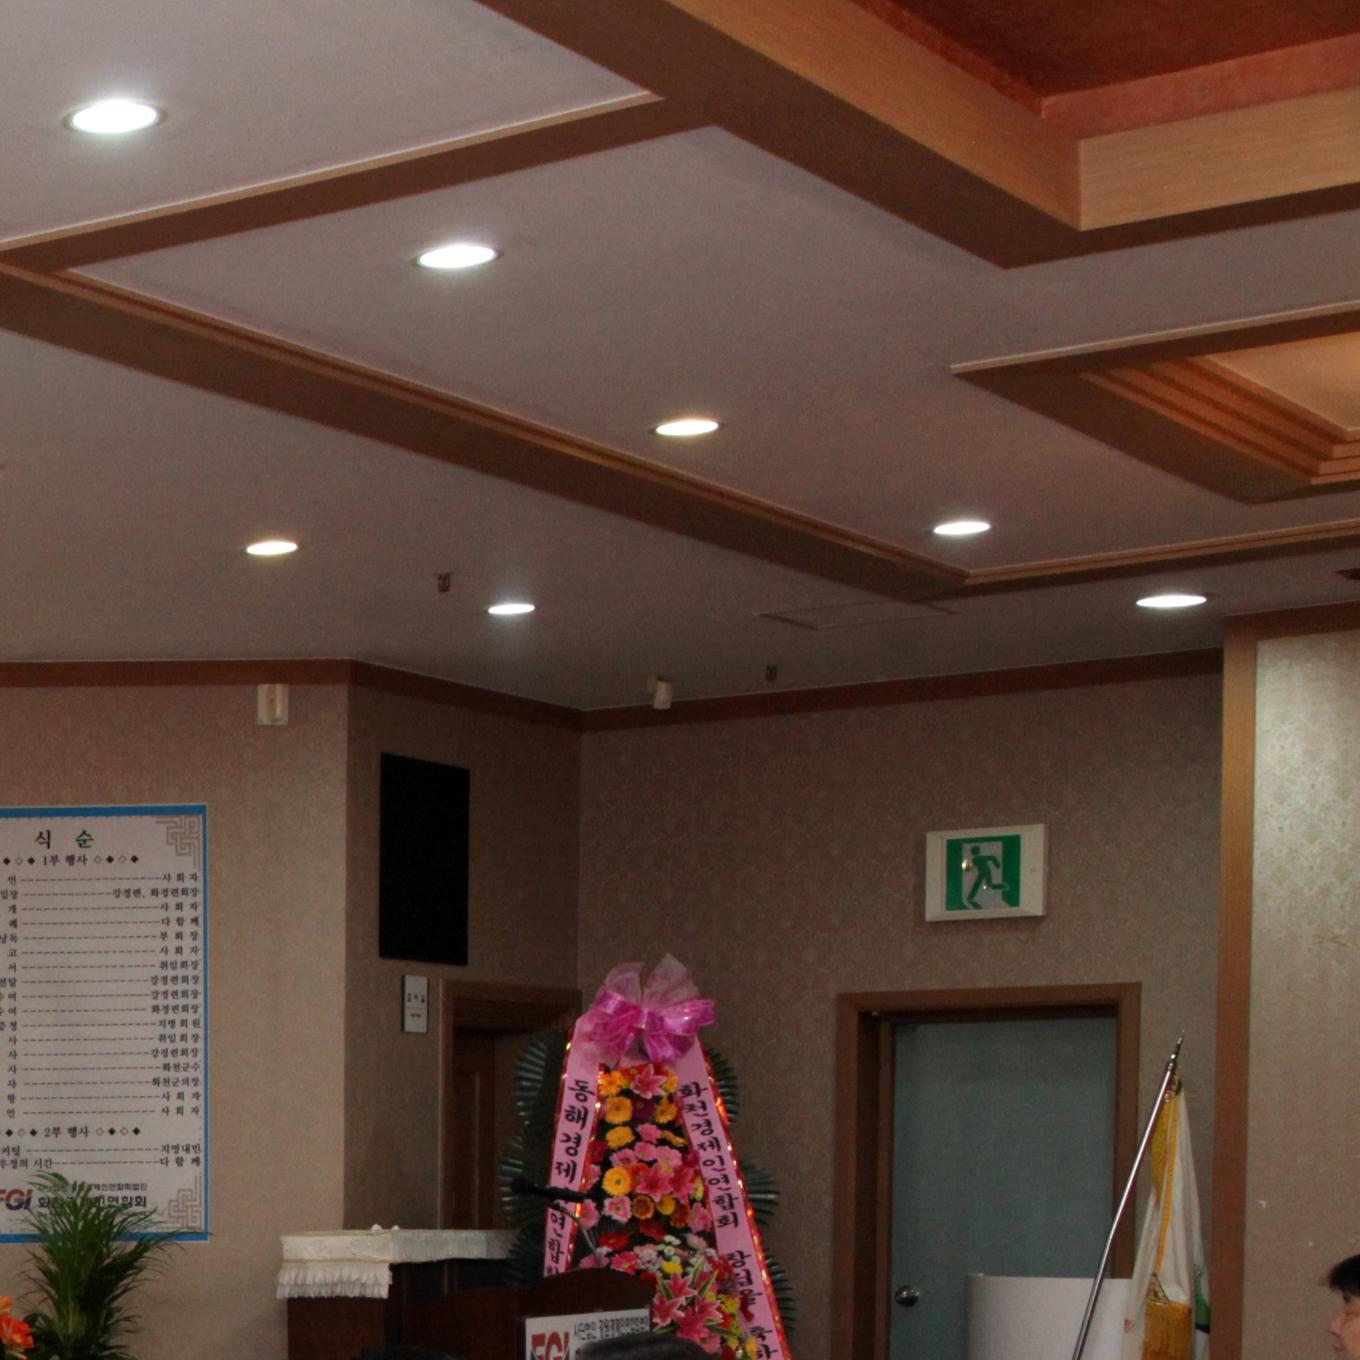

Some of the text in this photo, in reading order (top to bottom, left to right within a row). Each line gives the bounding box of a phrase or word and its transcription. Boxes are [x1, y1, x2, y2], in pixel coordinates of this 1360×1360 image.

[66, 854, 88, 867] 행사
[44, 1126, 90, 1139] 2부 행사
[0, 1158, 29, 1170] 우정의
[33, 1157, 53, 1168] 시간
